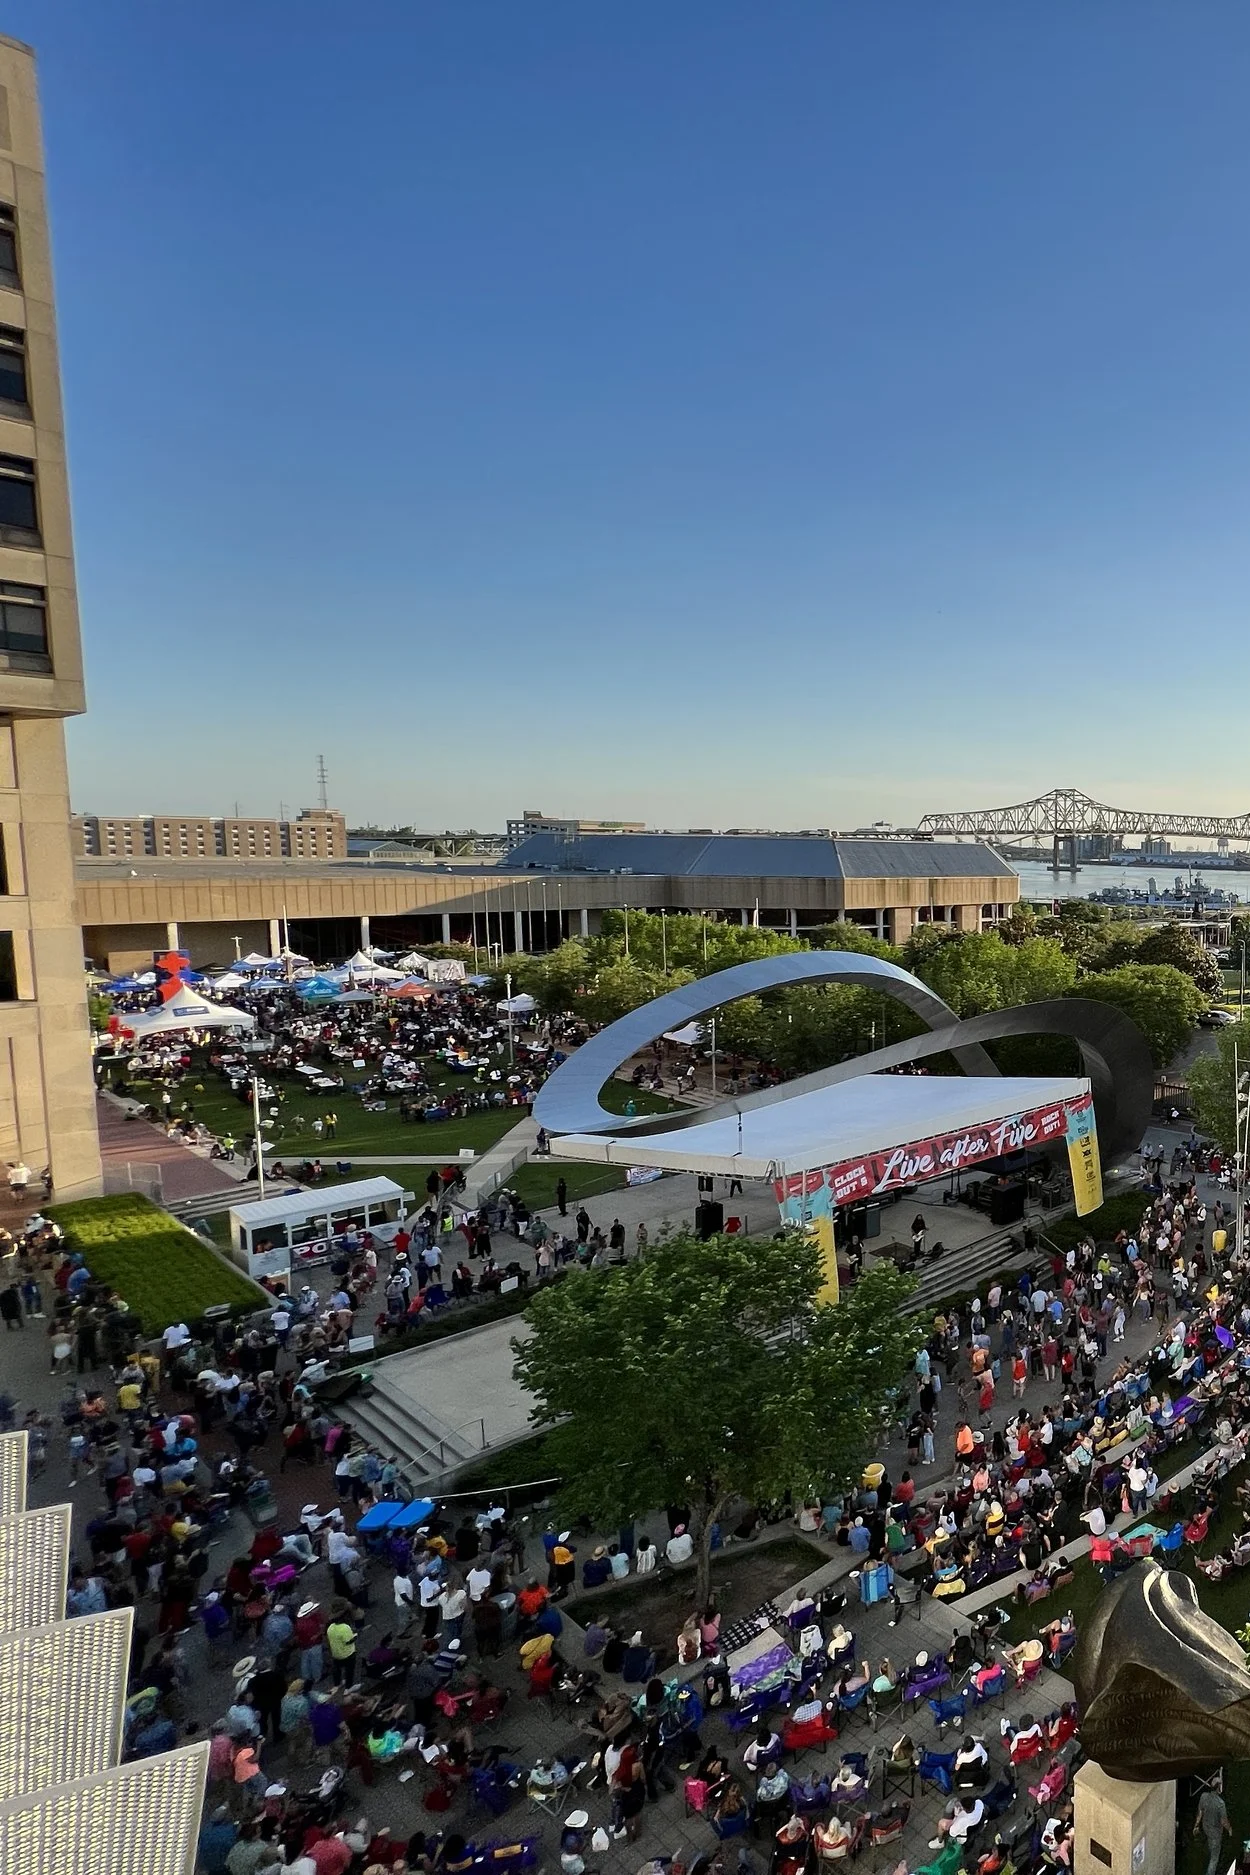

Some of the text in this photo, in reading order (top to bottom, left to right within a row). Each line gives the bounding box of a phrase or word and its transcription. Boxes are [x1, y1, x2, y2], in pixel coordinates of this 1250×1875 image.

[1041, 1110, 1060, 1126] ROCK
[1043, 1120, 1060, 1135] OUT!
[871, 1114, 1039, 1193] Live after Five
[834, 1165, 866, 1187] CLOCK
[836, 1181, 858, 1199] OUT
